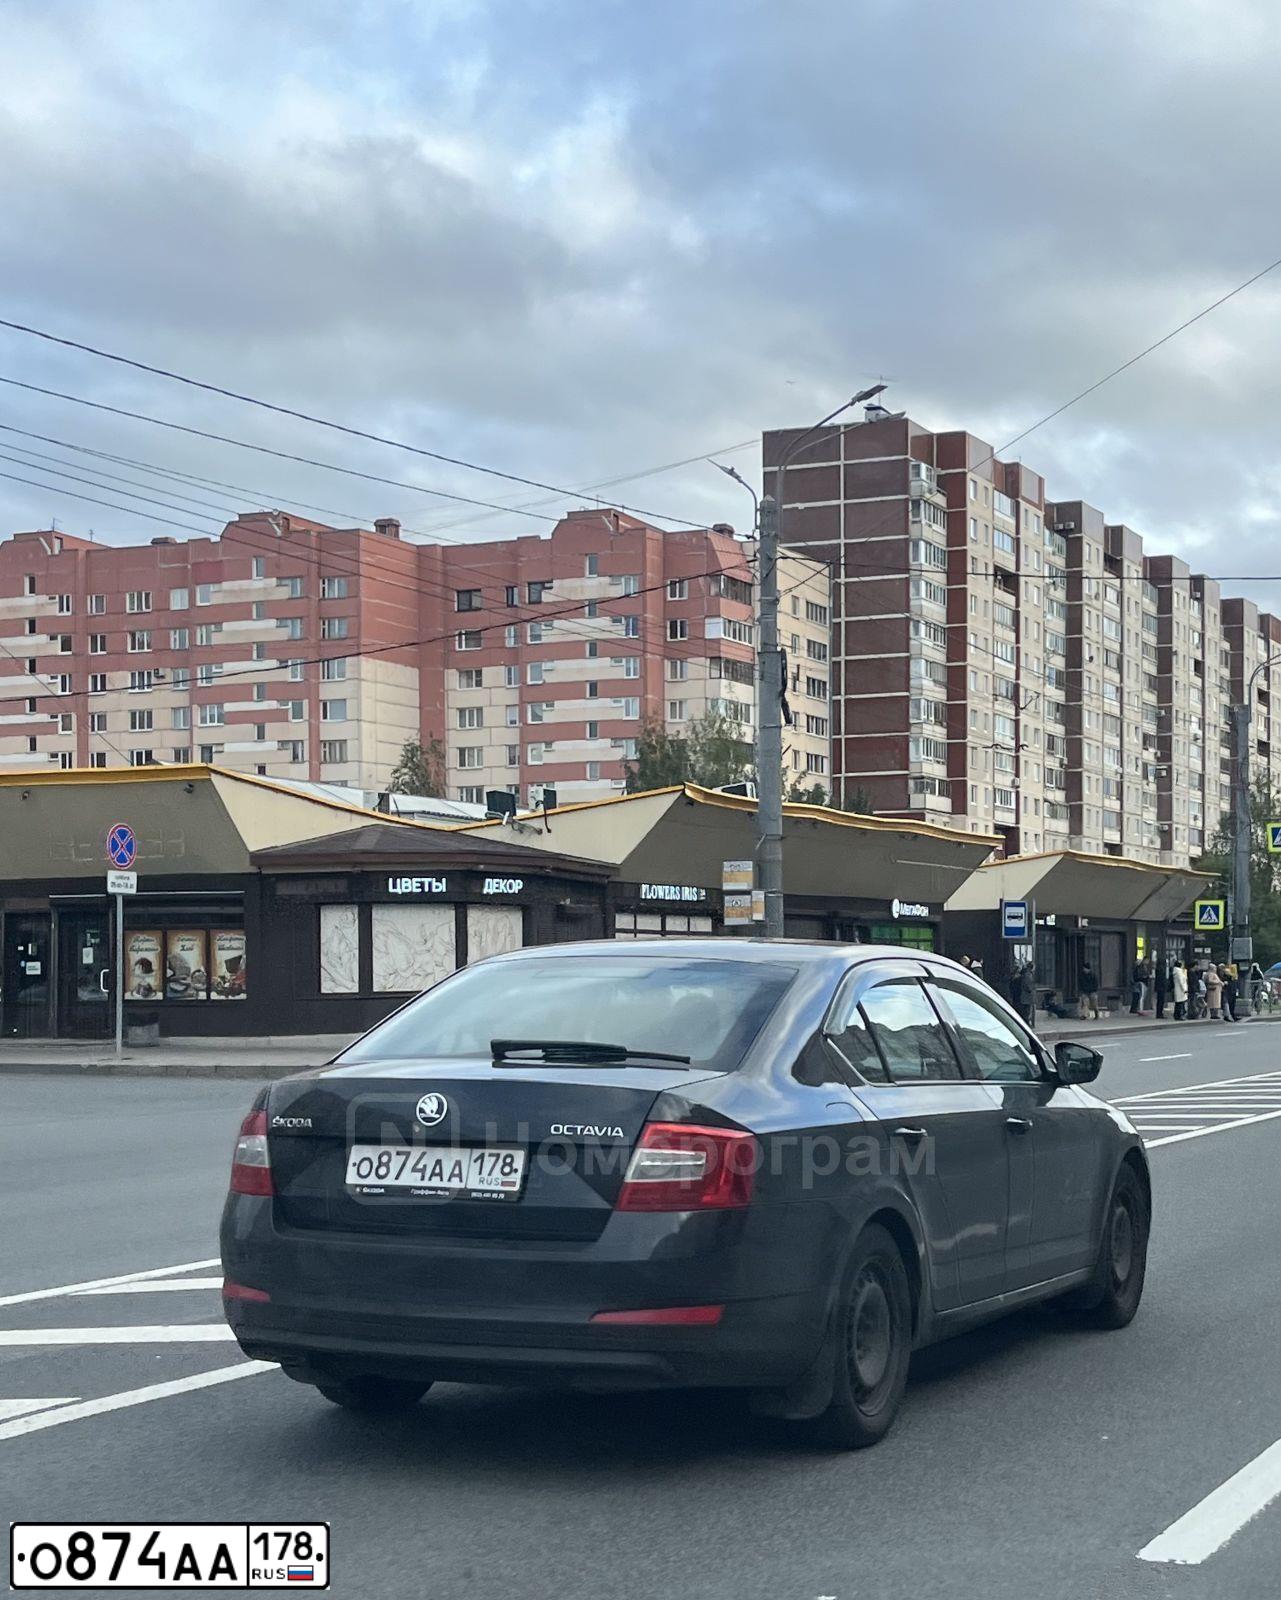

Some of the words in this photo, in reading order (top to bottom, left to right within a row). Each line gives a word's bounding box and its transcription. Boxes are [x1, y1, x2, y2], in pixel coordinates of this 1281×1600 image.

[388, 877, 447, 895] ЦВЕТЫ
[483, 878, 524, 895] ДЕКОР
[641, 883, 681, 901] FLOWERS
[681, 886, 698, 902] IRIS
[550, 1123, 624, 1138] OCTAVIA
[356, 1150, 464, 1183] О874АА
[473, 1152, 515, 1177] 178
[478, 1177, 500, 1187] RUS
